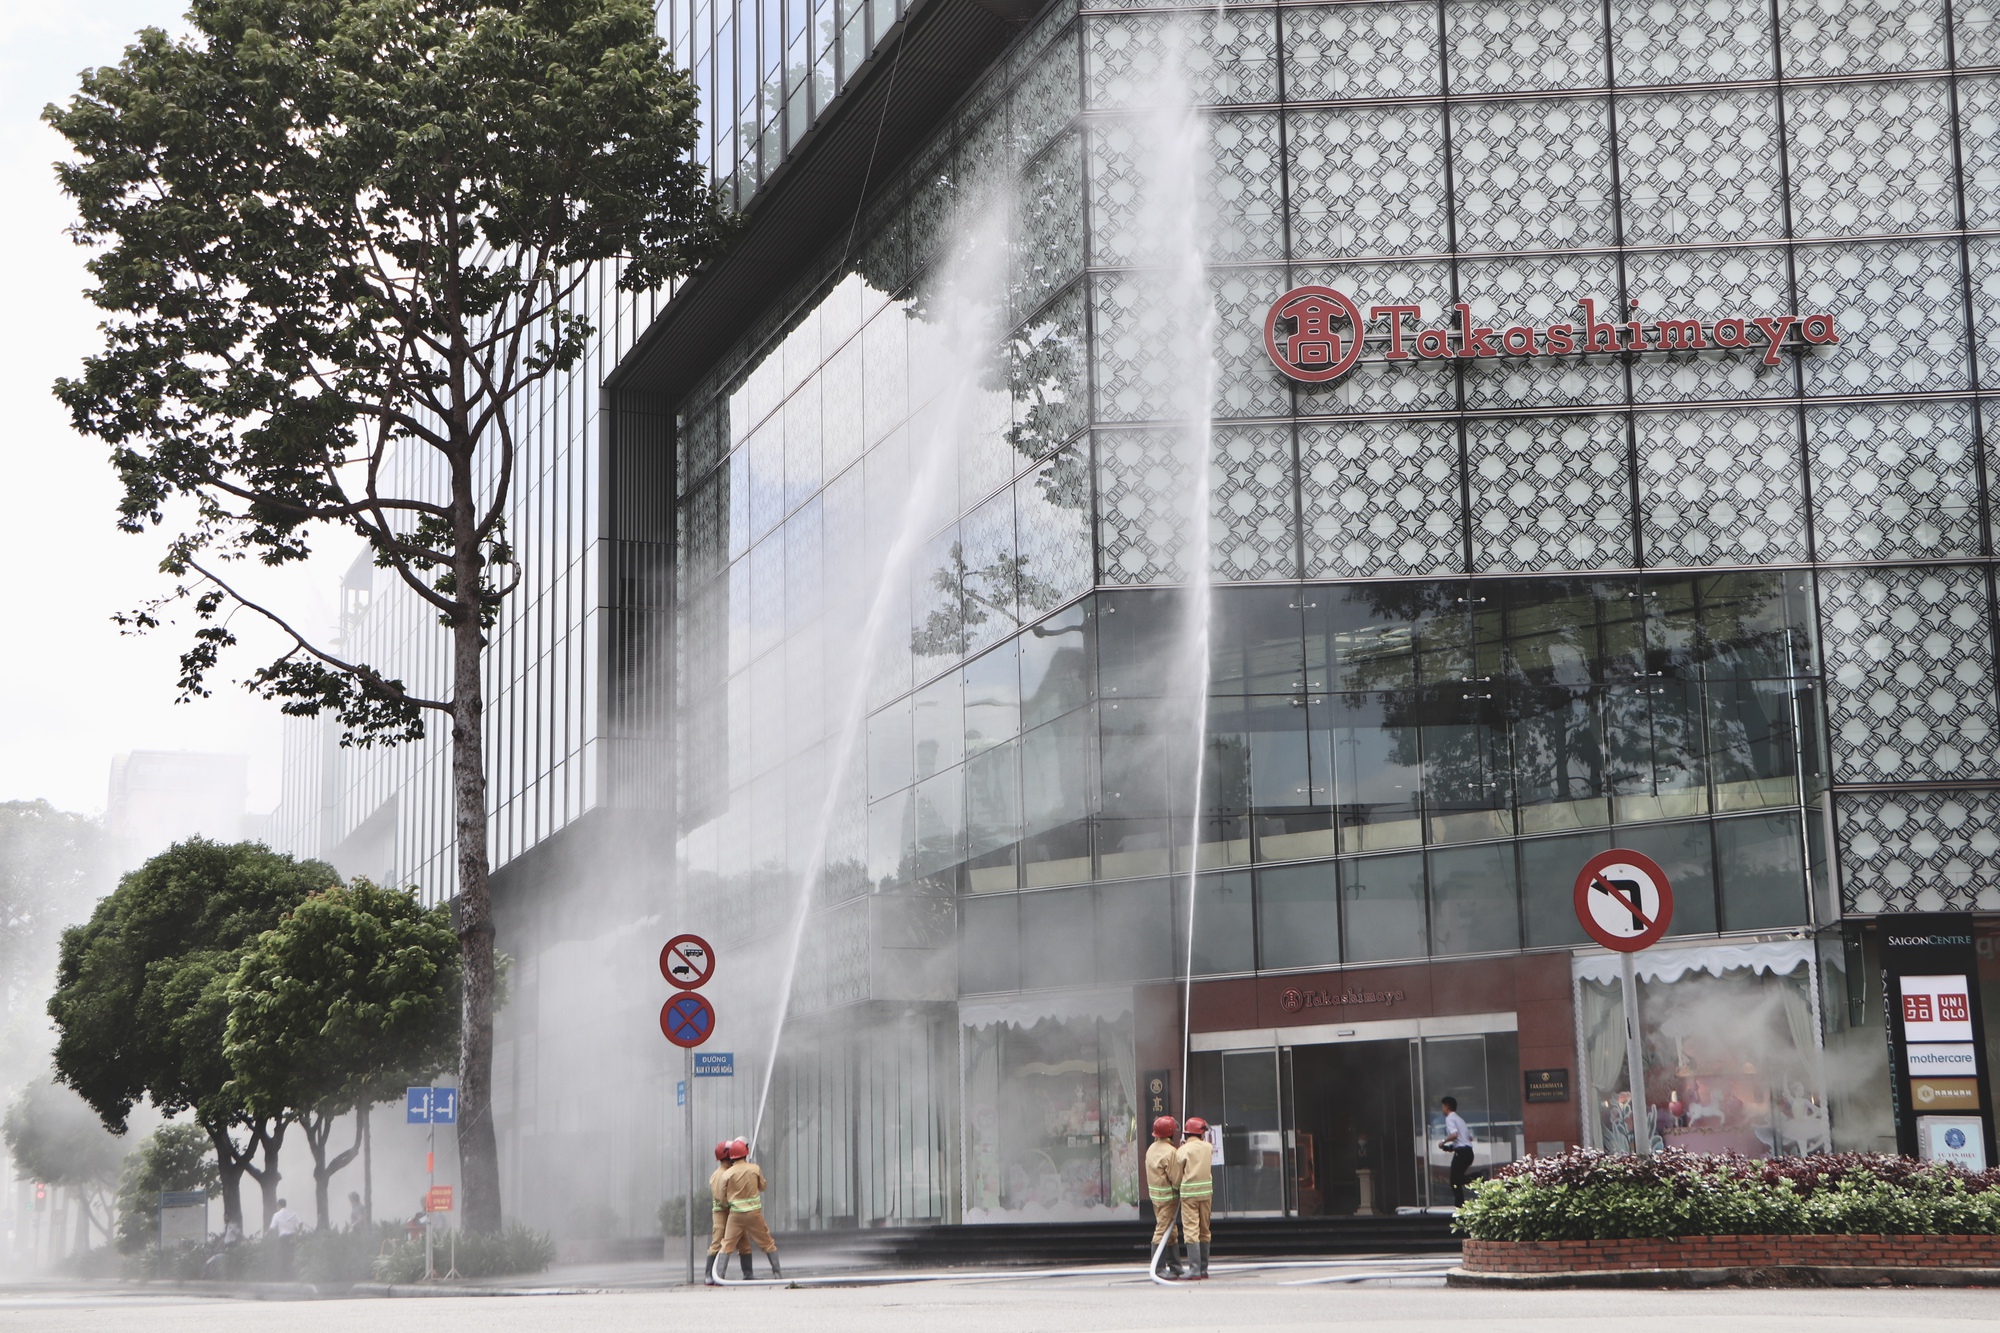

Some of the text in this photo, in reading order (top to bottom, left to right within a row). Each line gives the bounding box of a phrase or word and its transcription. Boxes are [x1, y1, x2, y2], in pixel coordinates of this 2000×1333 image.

[1370, 299, 1840, 366] Takashimaya
[1303, 987, 1405, 1006] Takashimaya
[1940, 996, 1962, 1007] UNI
[1942, 1008, 1965, 1020] QLO
[702, 1055, 727, 1063] ĐƯỜNG
[1910, 1053, 1973, 1063] mothercare
